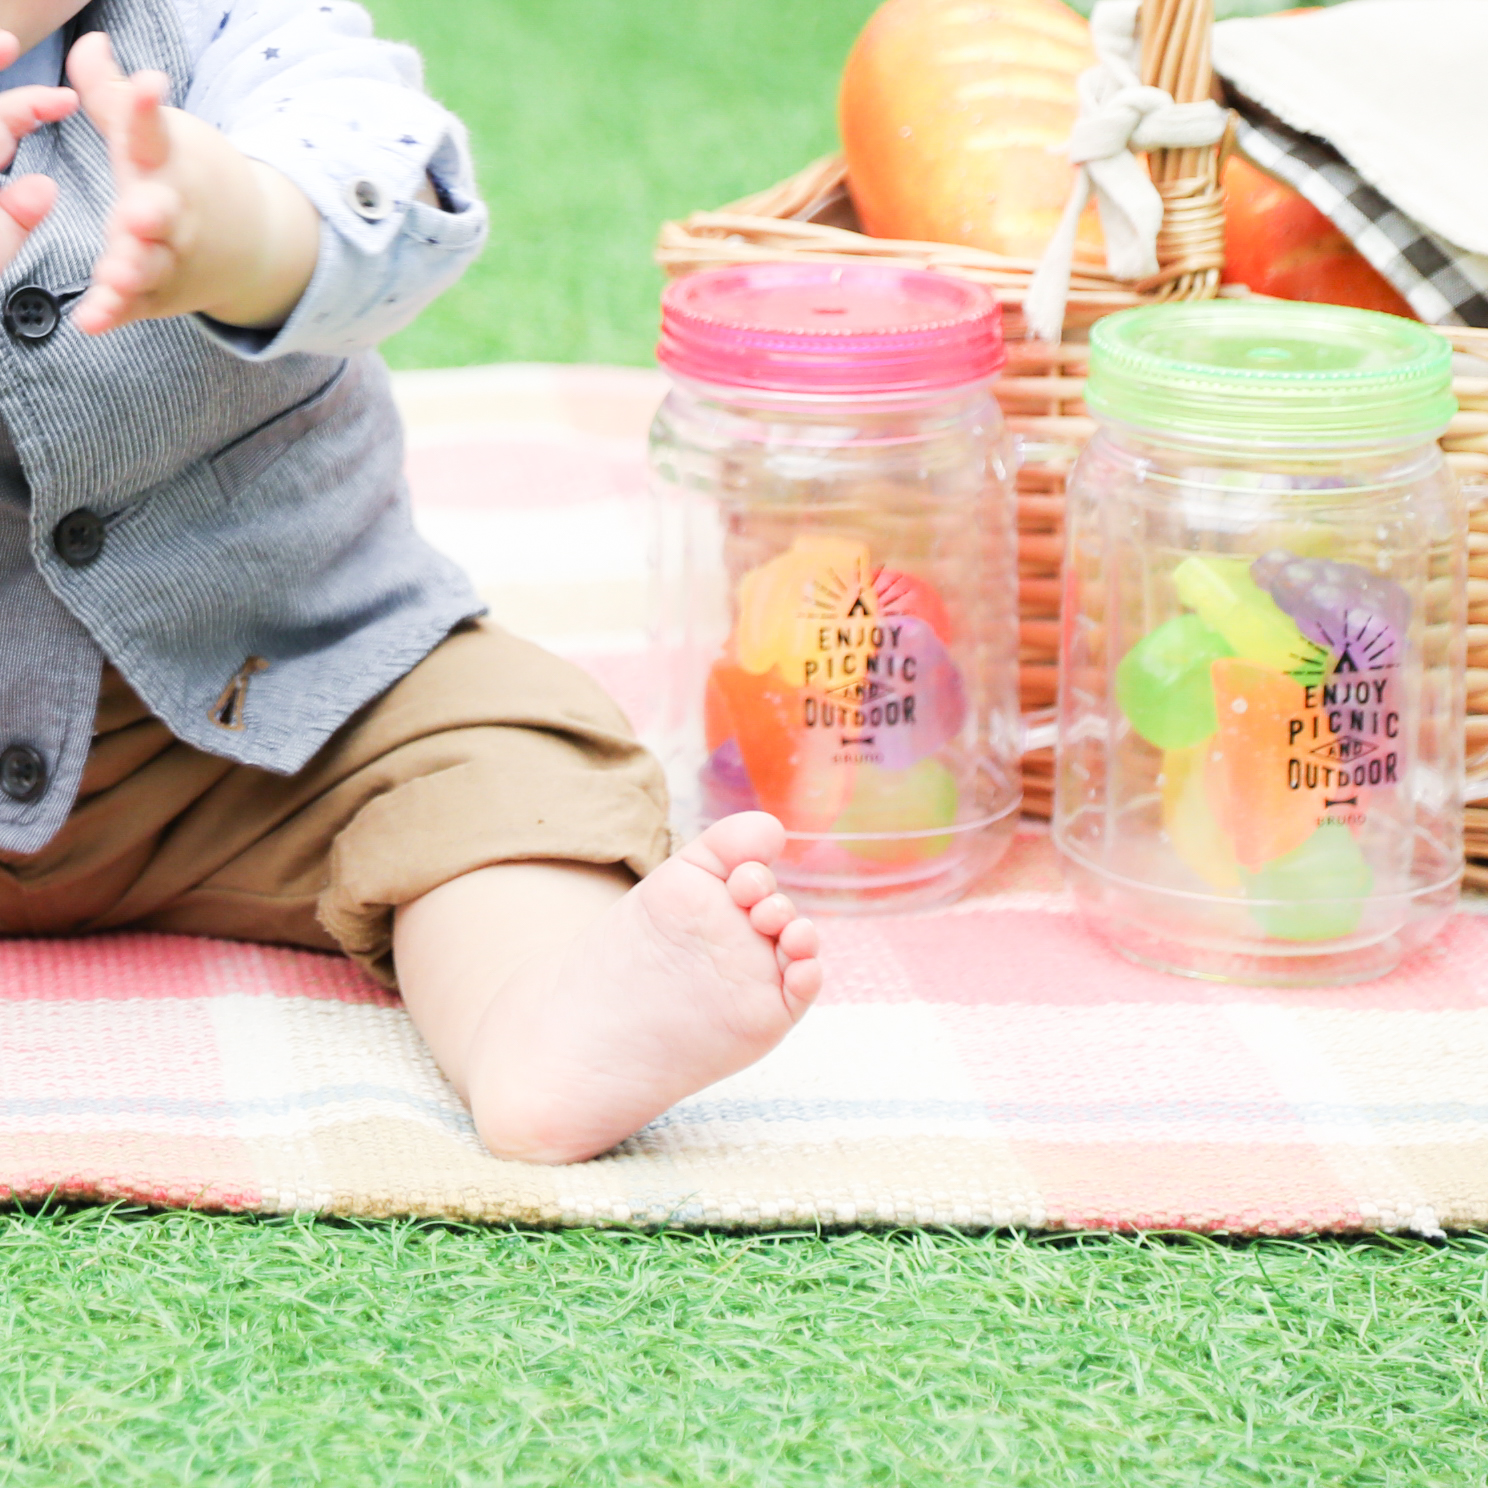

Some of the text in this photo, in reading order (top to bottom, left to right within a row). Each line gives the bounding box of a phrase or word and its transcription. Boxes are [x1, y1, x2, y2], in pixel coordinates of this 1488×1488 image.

[819, 625, 902, 651] ENJOY
[804, 653, 917, 686] PICNIC
[1304, 679, 1387, 709] ENJOY
[804, 695, 916, 728] OUTDOOR
[1288, 710, 1399, 746] PICNIC
[1327, 740, 1363, 758] AND
[1288, 753, 1397, 789] OUTDOOR
